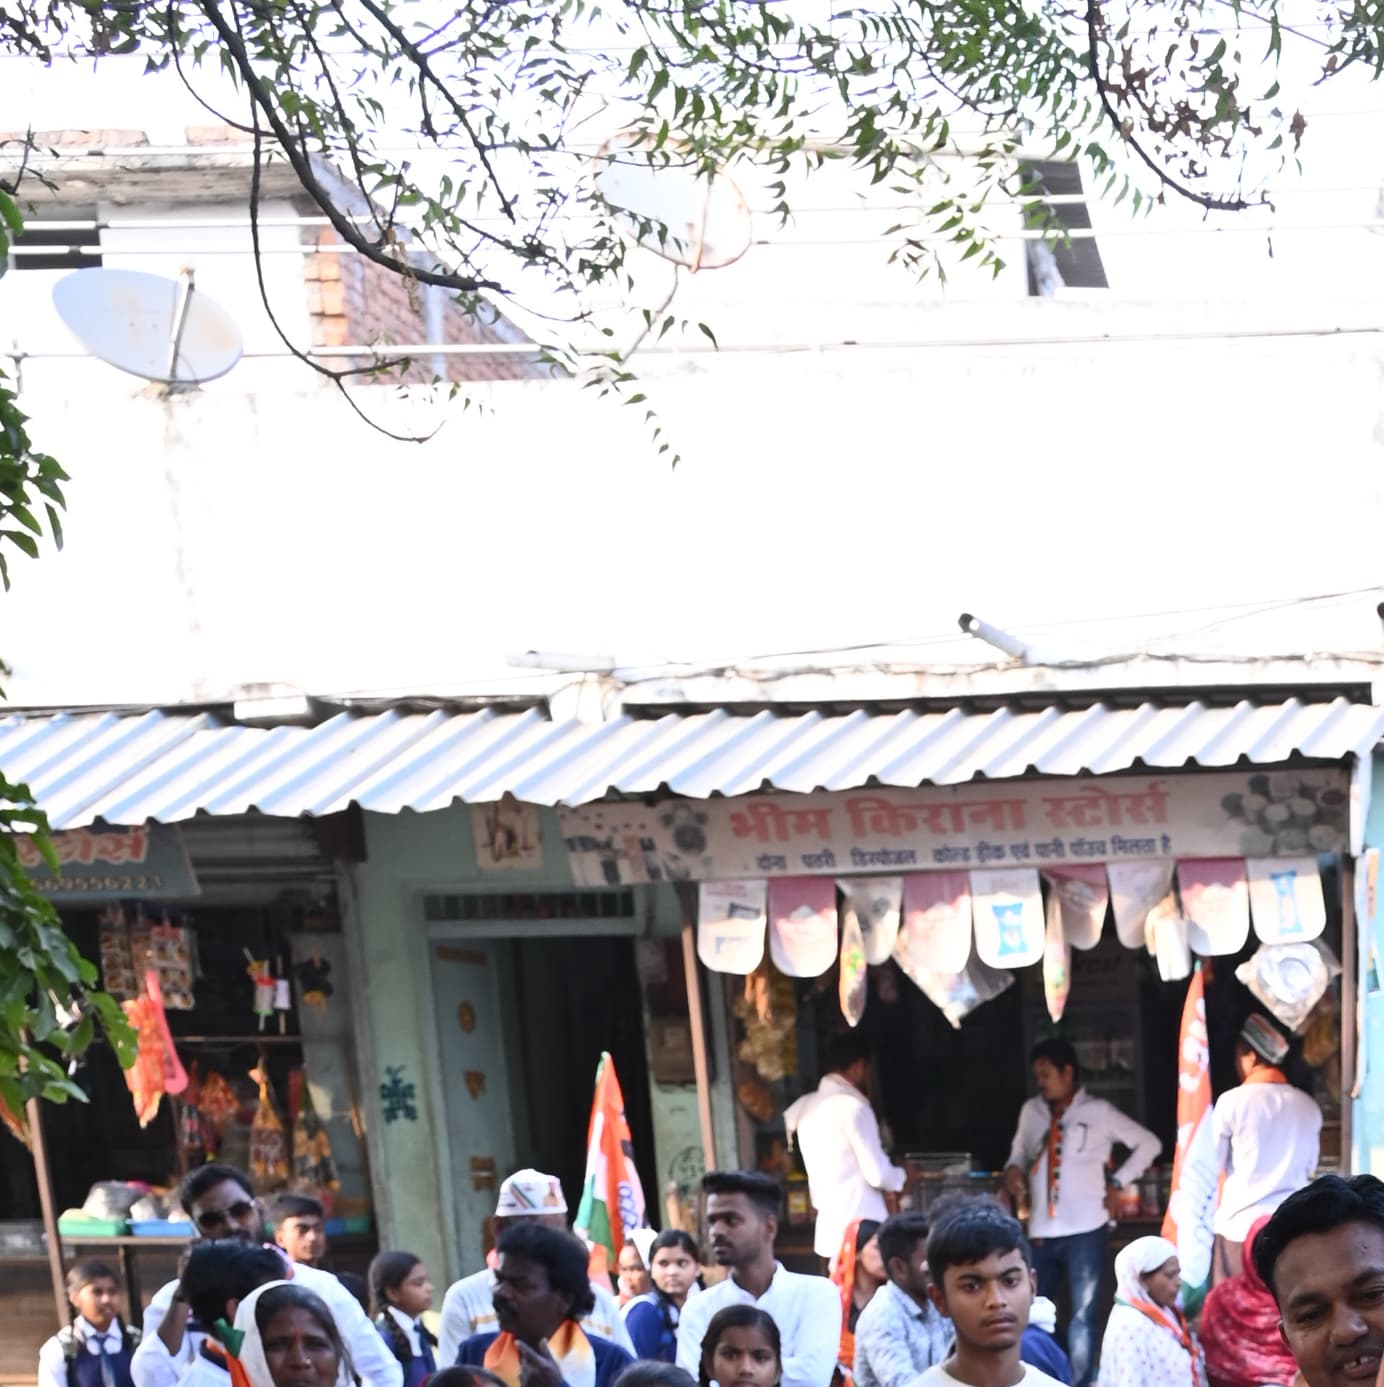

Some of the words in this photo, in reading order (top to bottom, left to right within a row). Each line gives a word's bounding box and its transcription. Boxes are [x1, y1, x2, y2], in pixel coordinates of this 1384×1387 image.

[729, 800, 833, 842] भीम
[846, 796, 1027, 838] किराना
[1041, 780, 1171, 829] स्टोर्स
